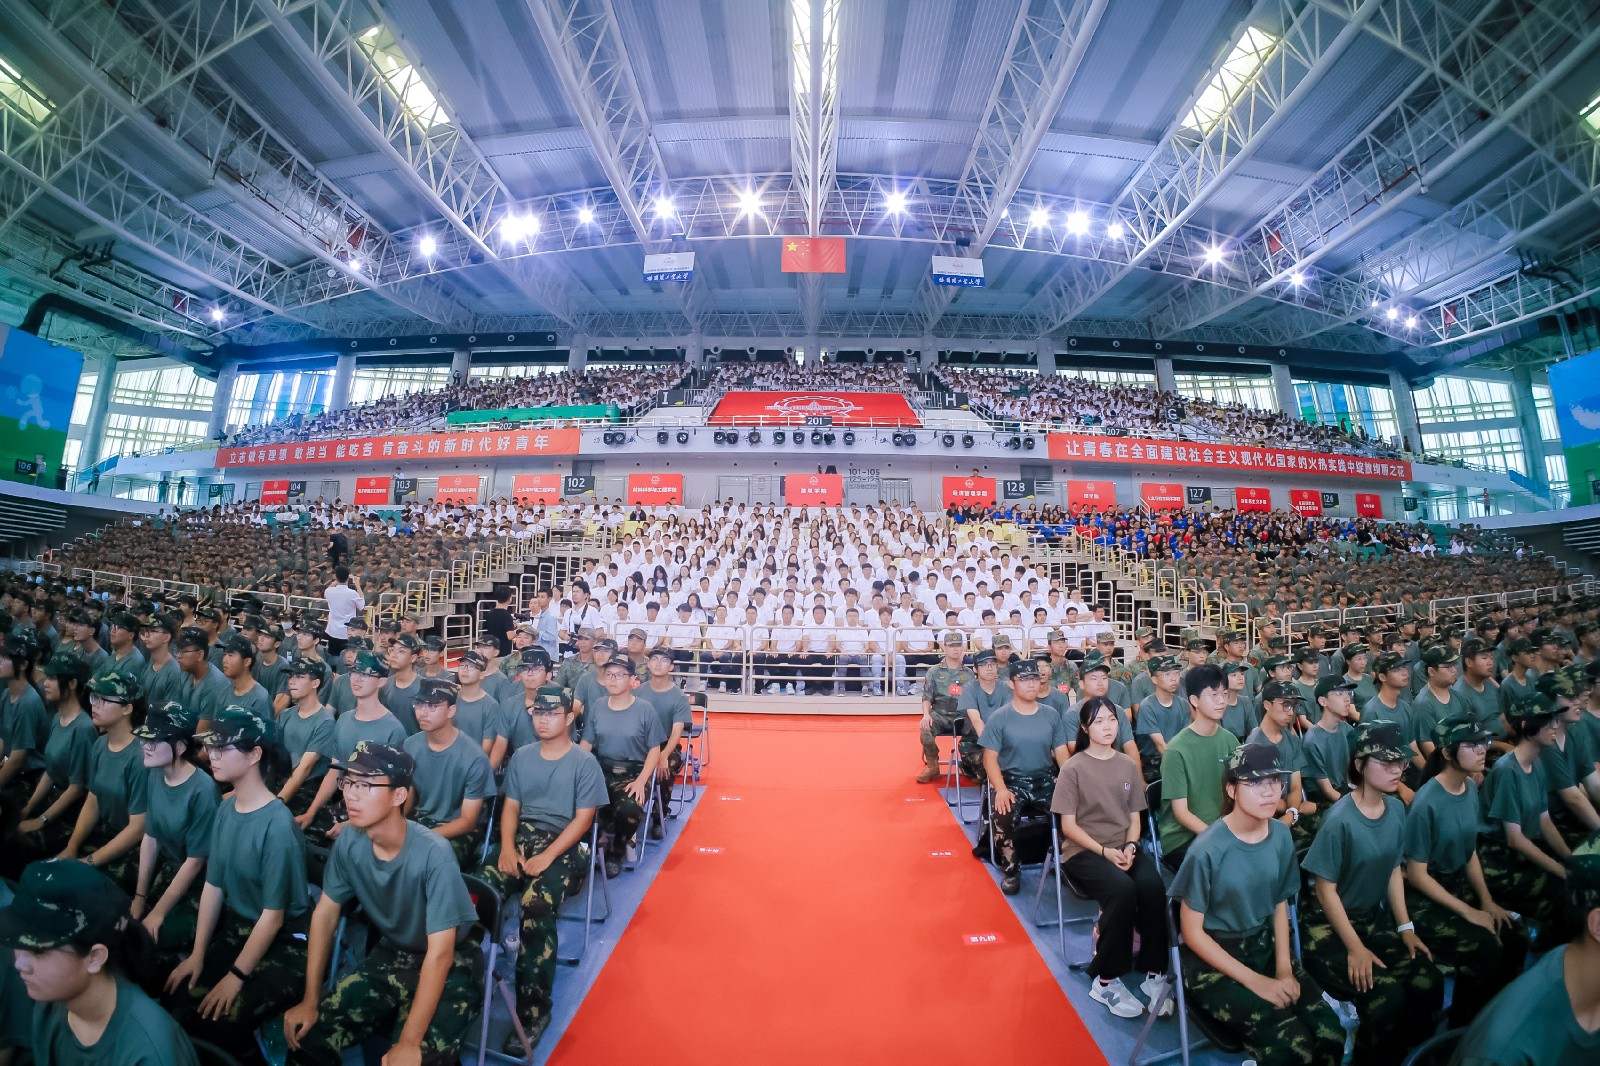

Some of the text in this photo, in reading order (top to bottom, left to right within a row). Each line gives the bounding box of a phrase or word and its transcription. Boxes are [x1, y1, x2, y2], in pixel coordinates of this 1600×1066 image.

[946, 393, 957, 407] H
[807, 417, 823, 425] 201
[499, 422, 513, 430] 202
[1106, 428, 1120, 436] 207
[229, 434, 550, 465] 立志做有理想 敢担当 能吃苦 肯奋斗的新时代好青年
[18, 461, 32, 471] 106
[849, 468, 880, 476] 101-105
[290, 482, 302, 491] 104
[396, 480, 410, 489] 103
[568, 477, 586, 488] 102
[1006, 482, 1026, 492] 128
[1190, 488, 1204, 498] 127
[970, 935, 997, 943] 第九排
